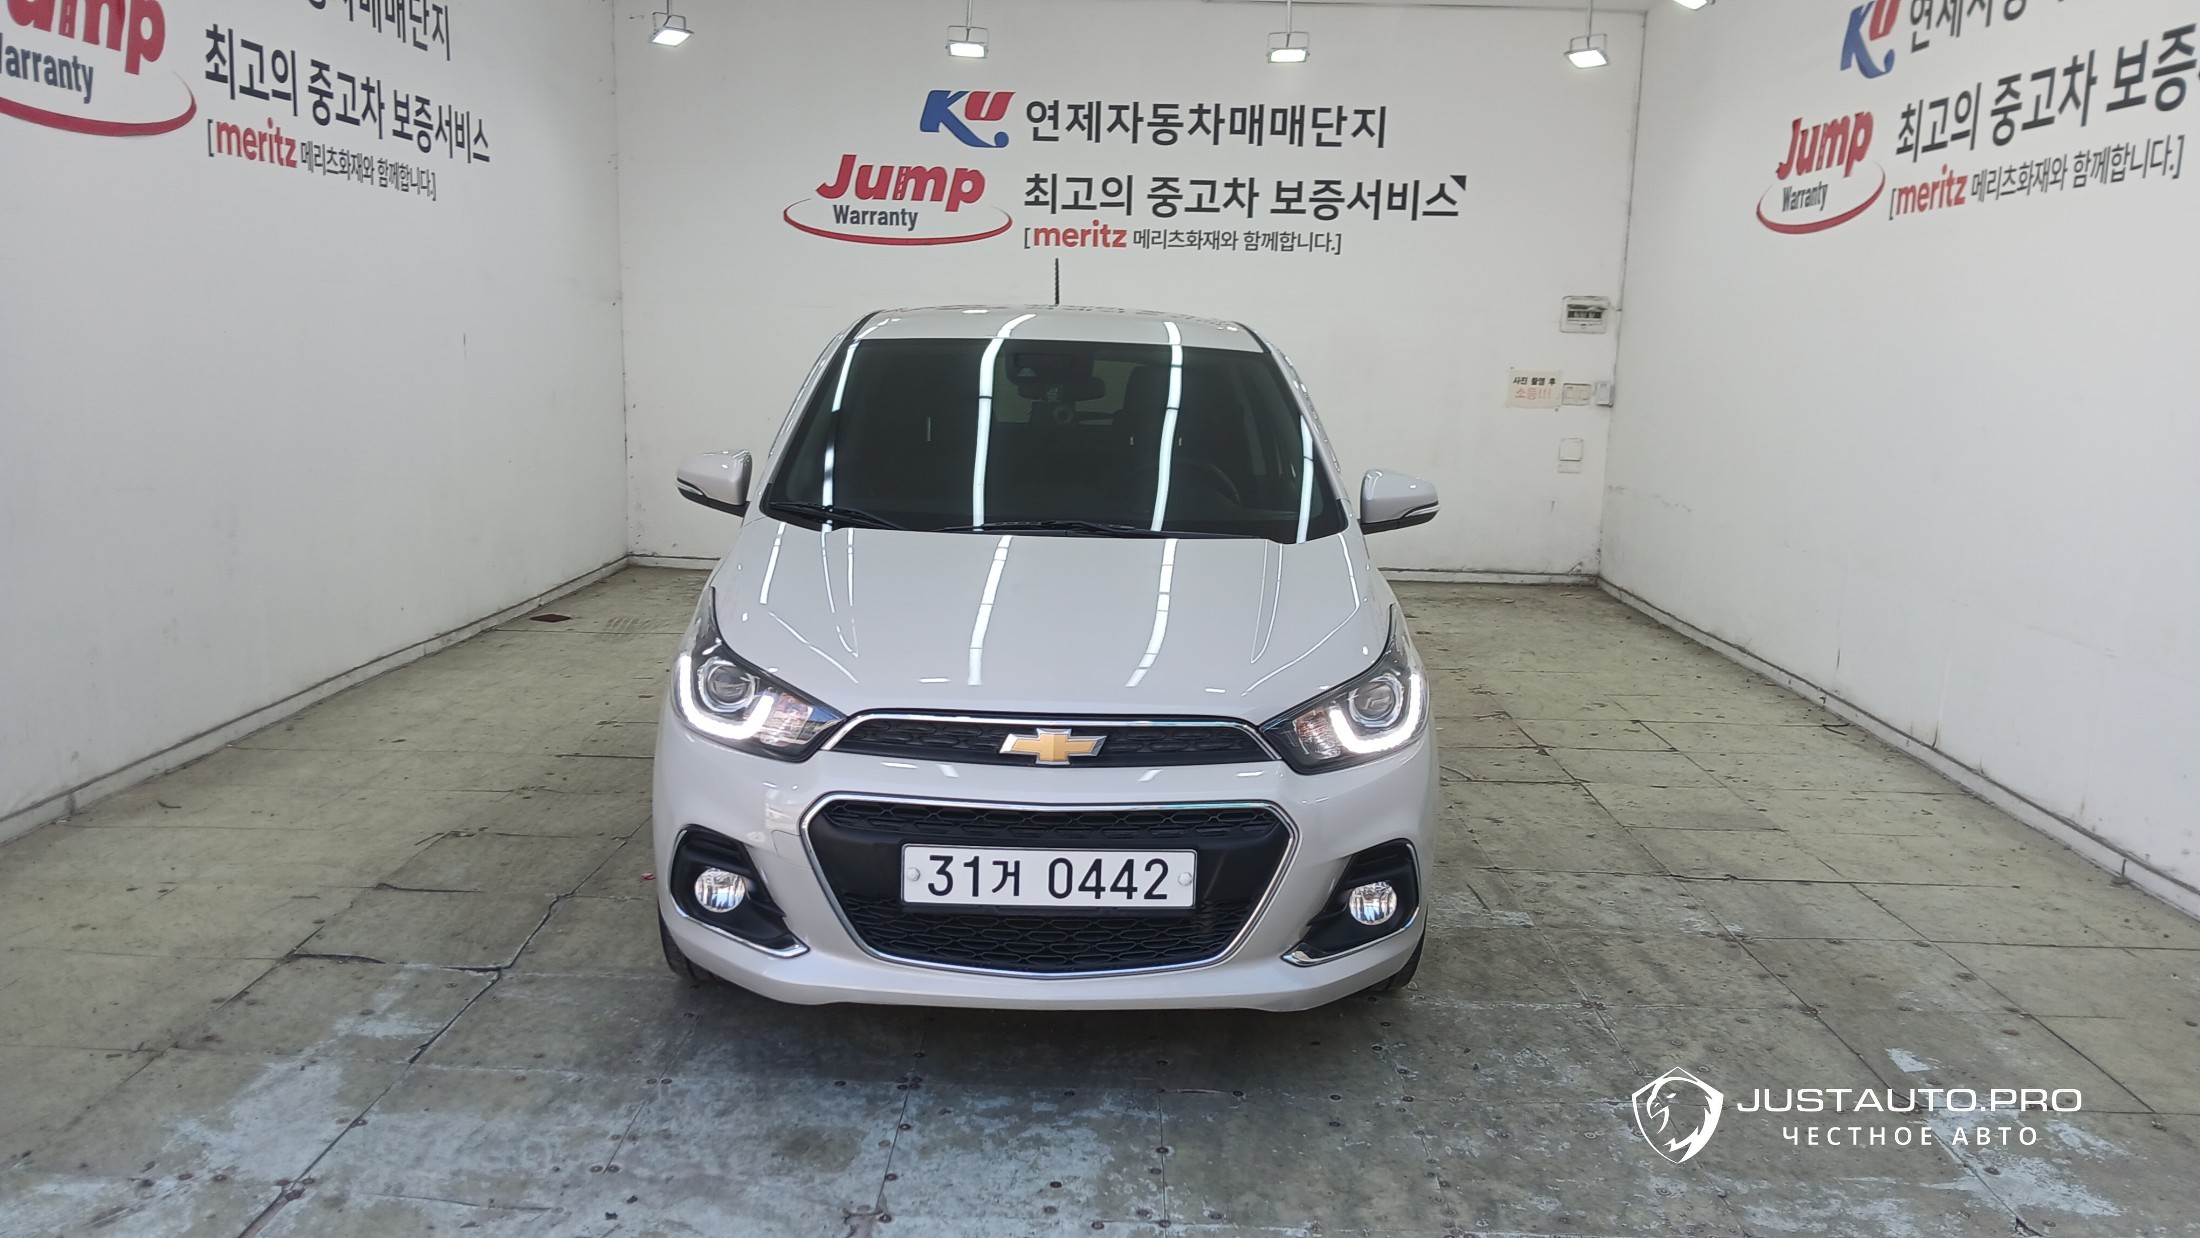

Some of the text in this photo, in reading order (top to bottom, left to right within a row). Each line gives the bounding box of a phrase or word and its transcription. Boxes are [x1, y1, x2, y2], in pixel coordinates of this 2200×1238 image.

[308, 0, 451, 62] 매매단지
[0, 32, 94, 104] arranty
[204, 23, 491, 164] 최고의 중고차 보증서비스
[1896, 24, 2200, 163] 최고의 중고차 보증
[1027, 100, 1386, 148] 연제자동차매매단지
[1776, 112, 1873, 180] Jump
[301, 141, 375, 185] 메리츠화재와
[815, 154, 986, 212] Jump
[1971, 154, 2068, 202] 메리츠화재와
[833, 205, 918, 231] Warranty
[1023, 173, 1460, 221] 최고의 중고차 보증서비스
[1782, 180, 1829, 213] Warranty
[1133, 229, 1239, 251] 메리츠화재와
[927, 854, 1170, 900] 31거 0442
